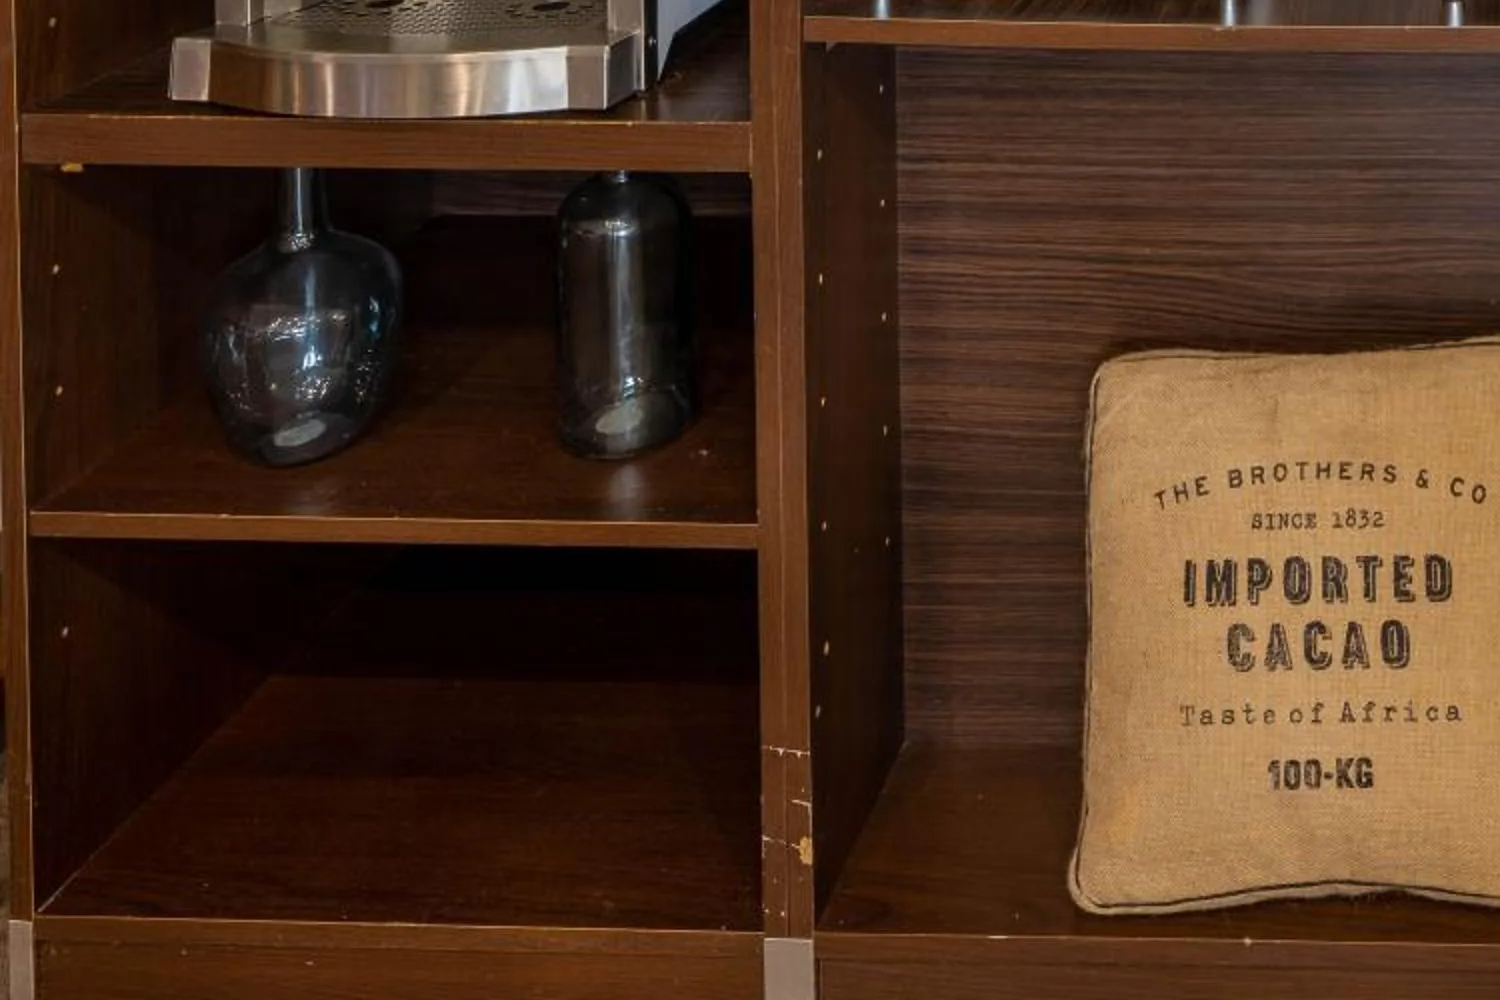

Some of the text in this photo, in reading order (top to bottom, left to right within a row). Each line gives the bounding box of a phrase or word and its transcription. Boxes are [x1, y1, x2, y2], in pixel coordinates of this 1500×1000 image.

[1154, 461, 1487, 511] THE BROTHERS & CO
[1251, 512, 1317, 530] SINCE
[1182, 553, 1454, 608] IMPORTED
[1226, 619, 1411, 672] CACAO
[1180, 700, 1463, 727] Taste of Africa
[1267, 756, 1374, 791] 100-KG
